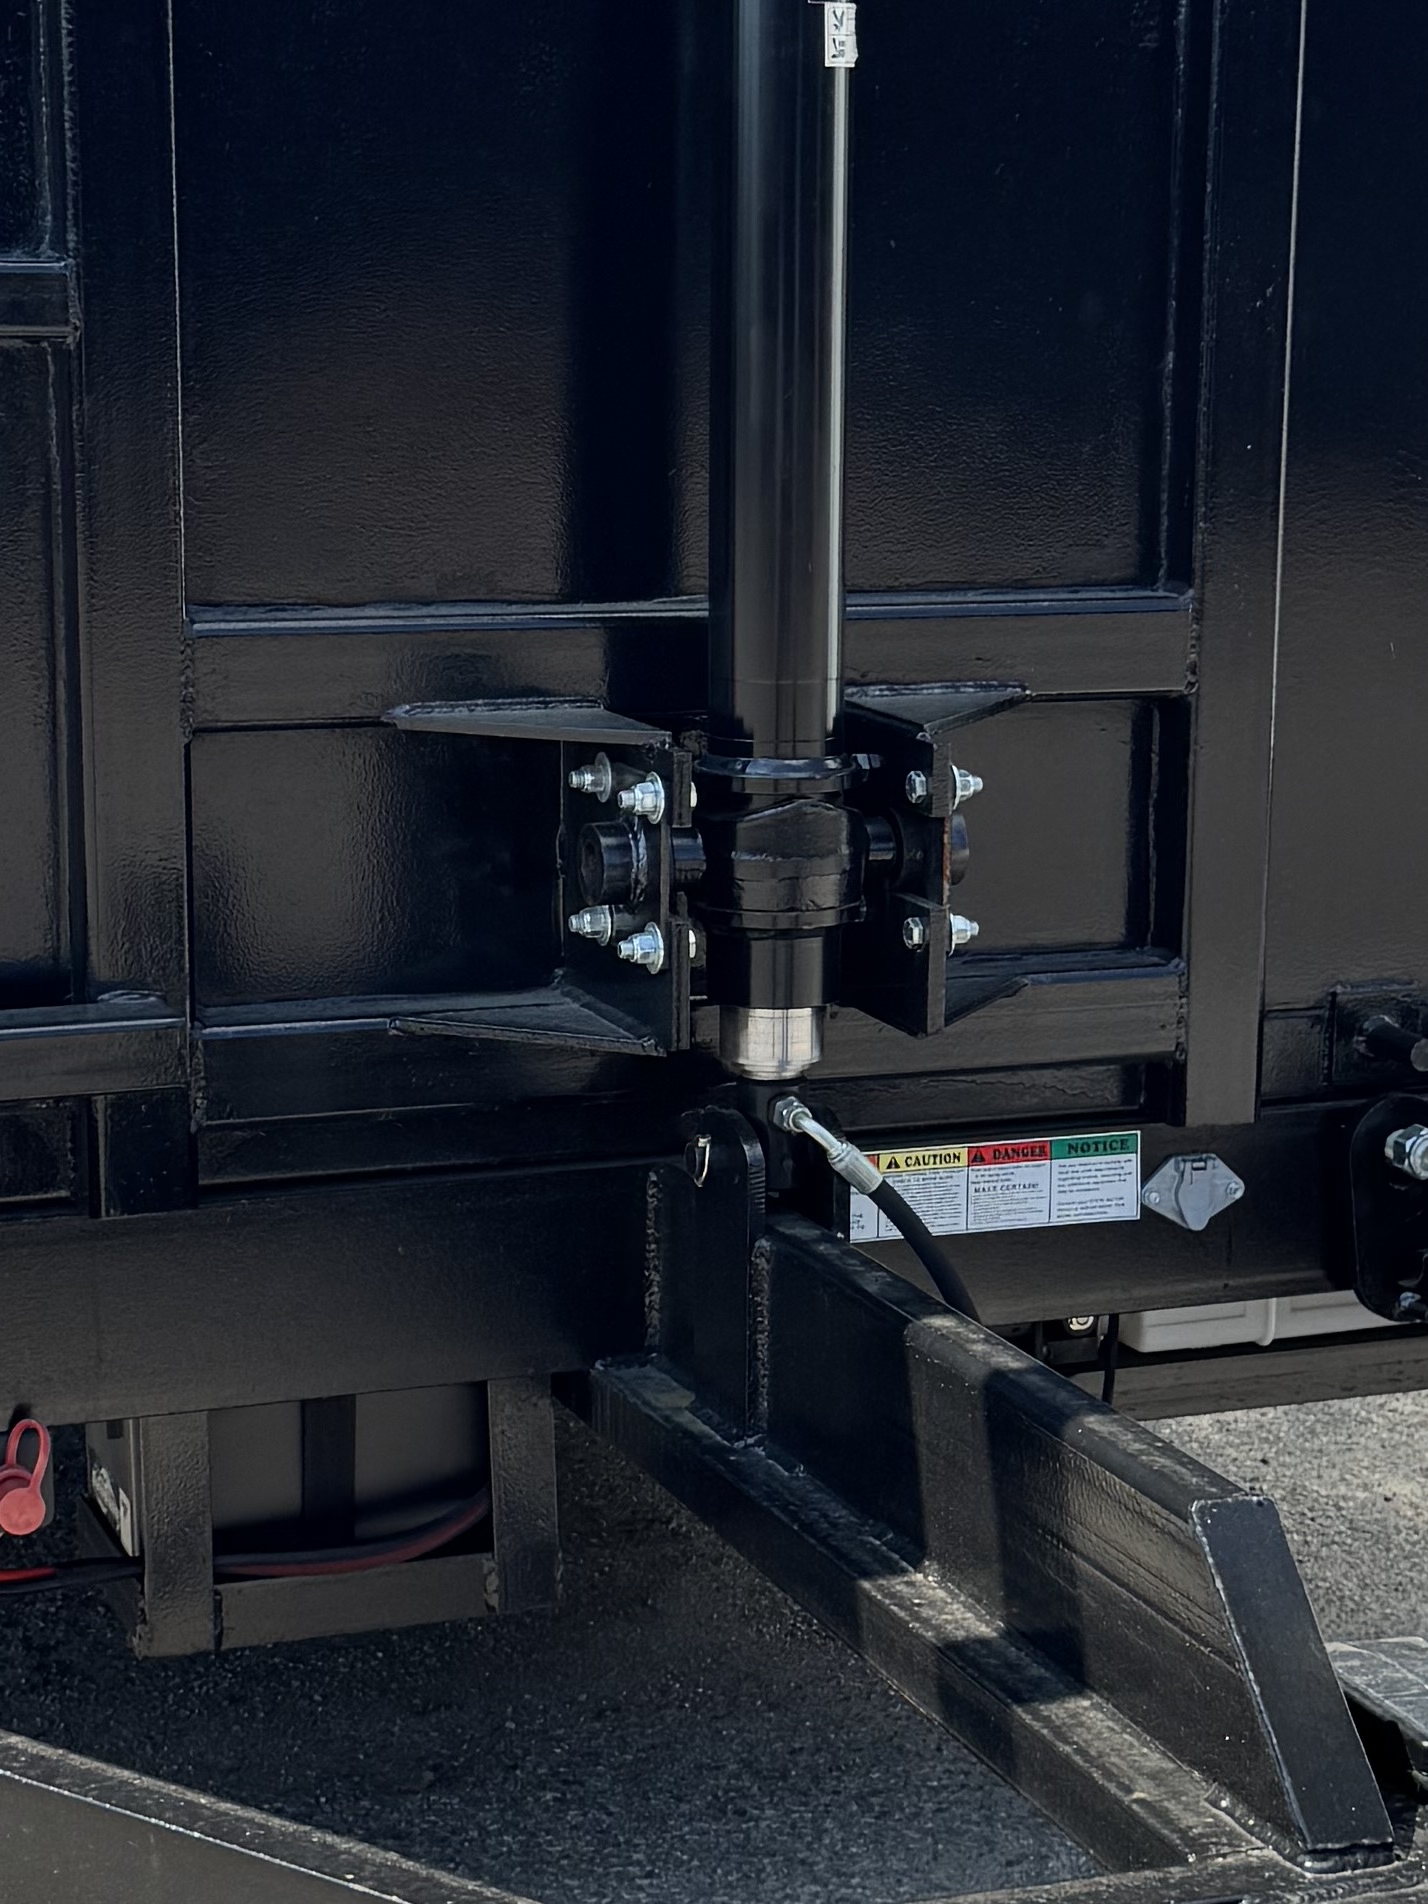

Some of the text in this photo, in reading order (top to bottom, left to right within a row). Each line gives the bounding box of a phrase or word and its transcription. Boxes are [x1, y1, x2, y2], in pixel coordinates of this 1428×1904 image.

[993, 1145, 1047, 1161] DANGER
[1067, 1138, 1130, 1155] NOTICE
[904, 1152, 961, 1168] CAUTION
